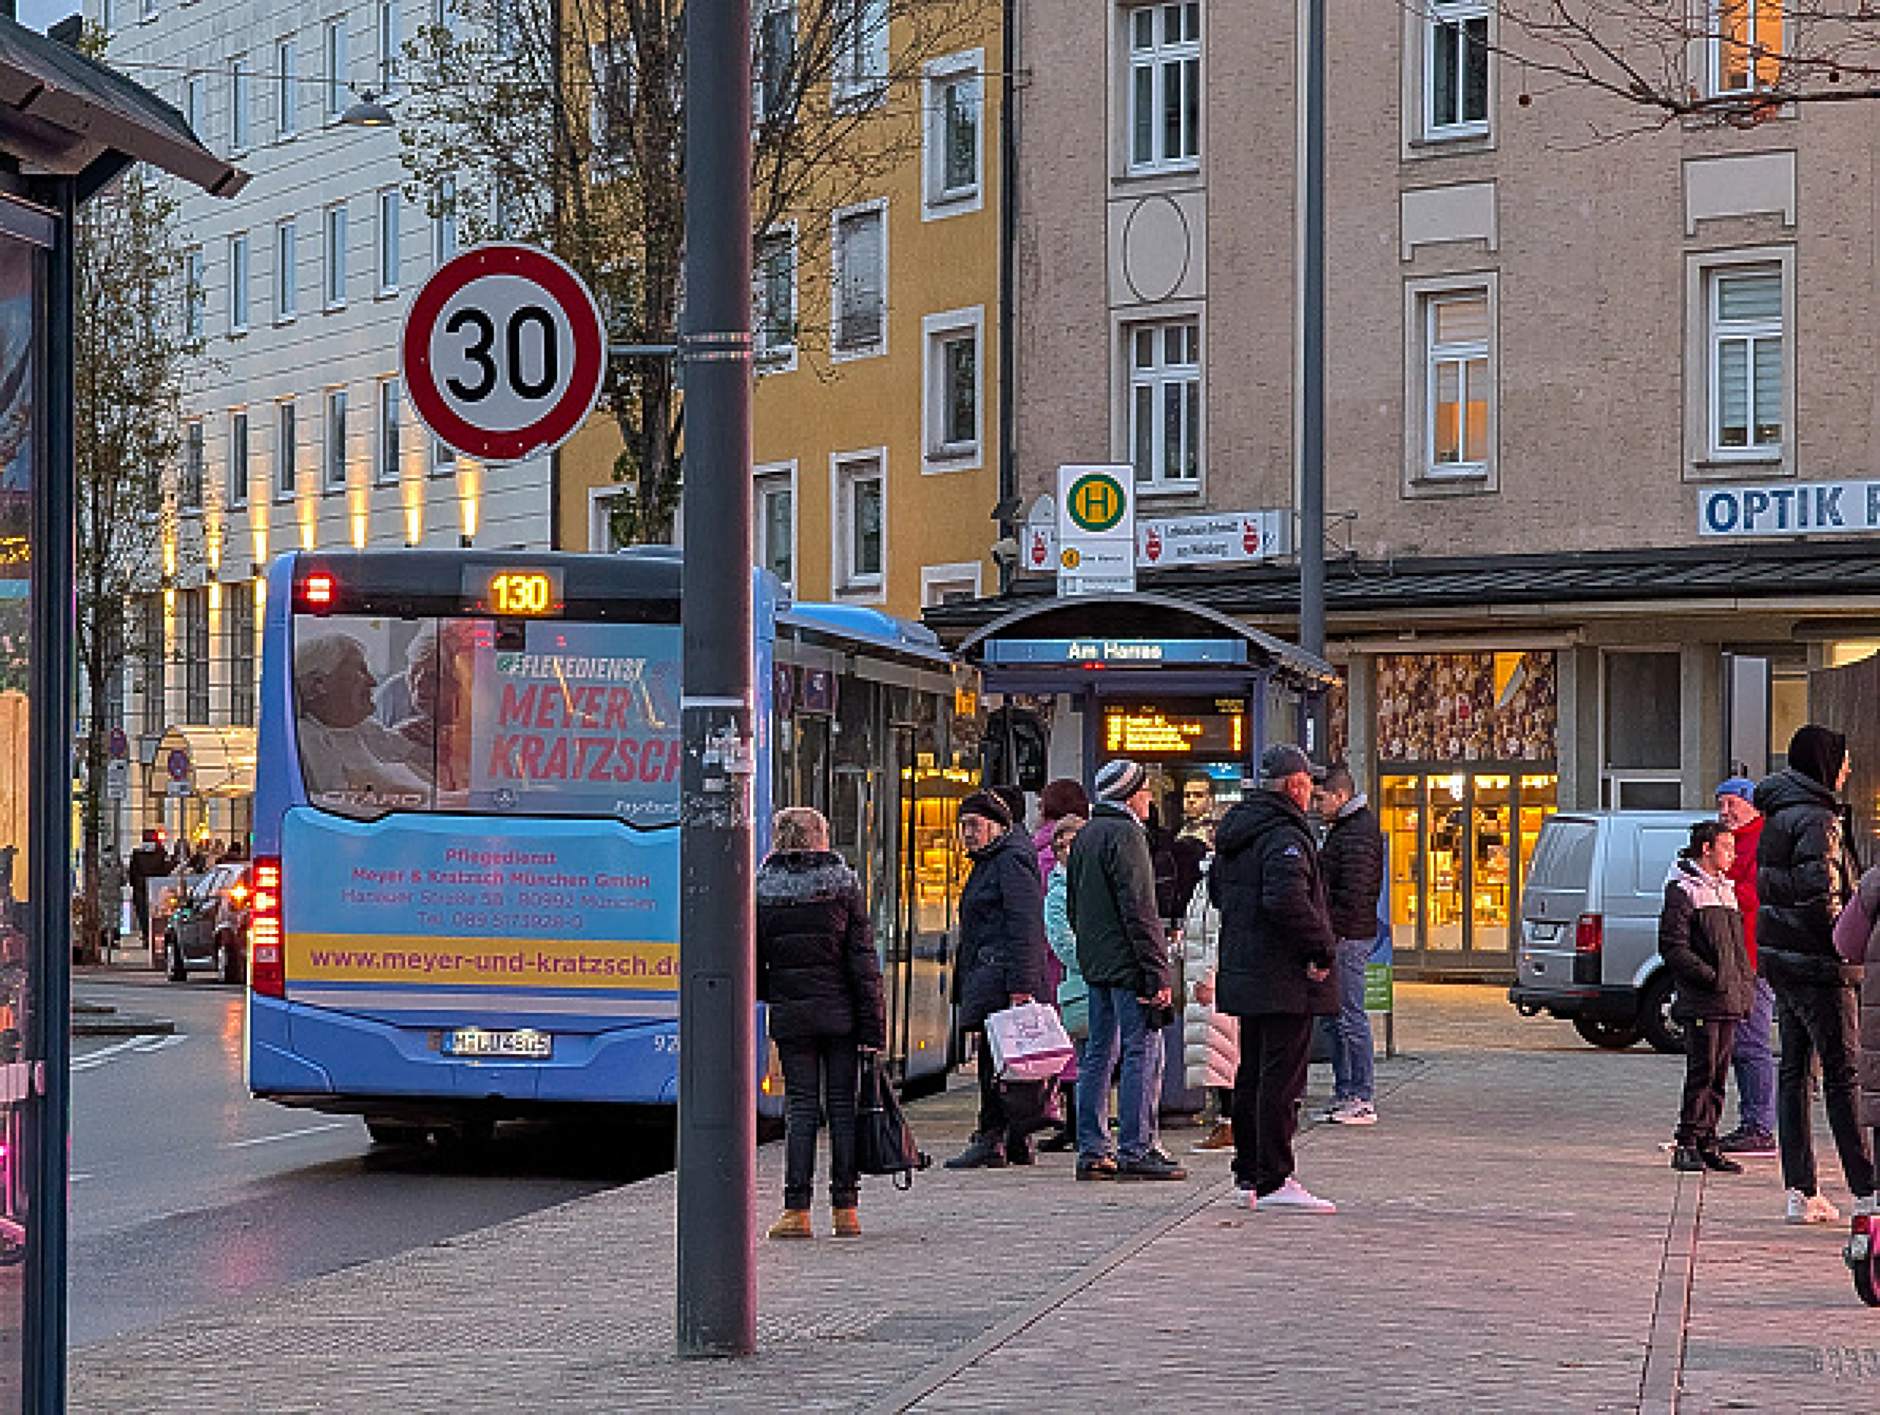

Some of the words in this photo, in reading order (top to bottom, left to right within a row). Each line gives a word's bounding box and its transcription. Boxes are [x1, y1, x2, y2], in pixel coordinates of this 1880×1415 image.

[445, 304, 559, 402] 30
[1085, 486, 1109, 518] H
[1705, 486, 1846, 532] OPTIK
[492, 574, 549, 612] 130
[496, 683, 632, 731] MEYER
[353, 867, 403, 884] Meyer
[427, 869, 504, 886] Kratzsch
[509, 870, 590, 888] München
[594, 872, 650, 888] GmbH
[445, 848, 557, 869] Pflegedienst
